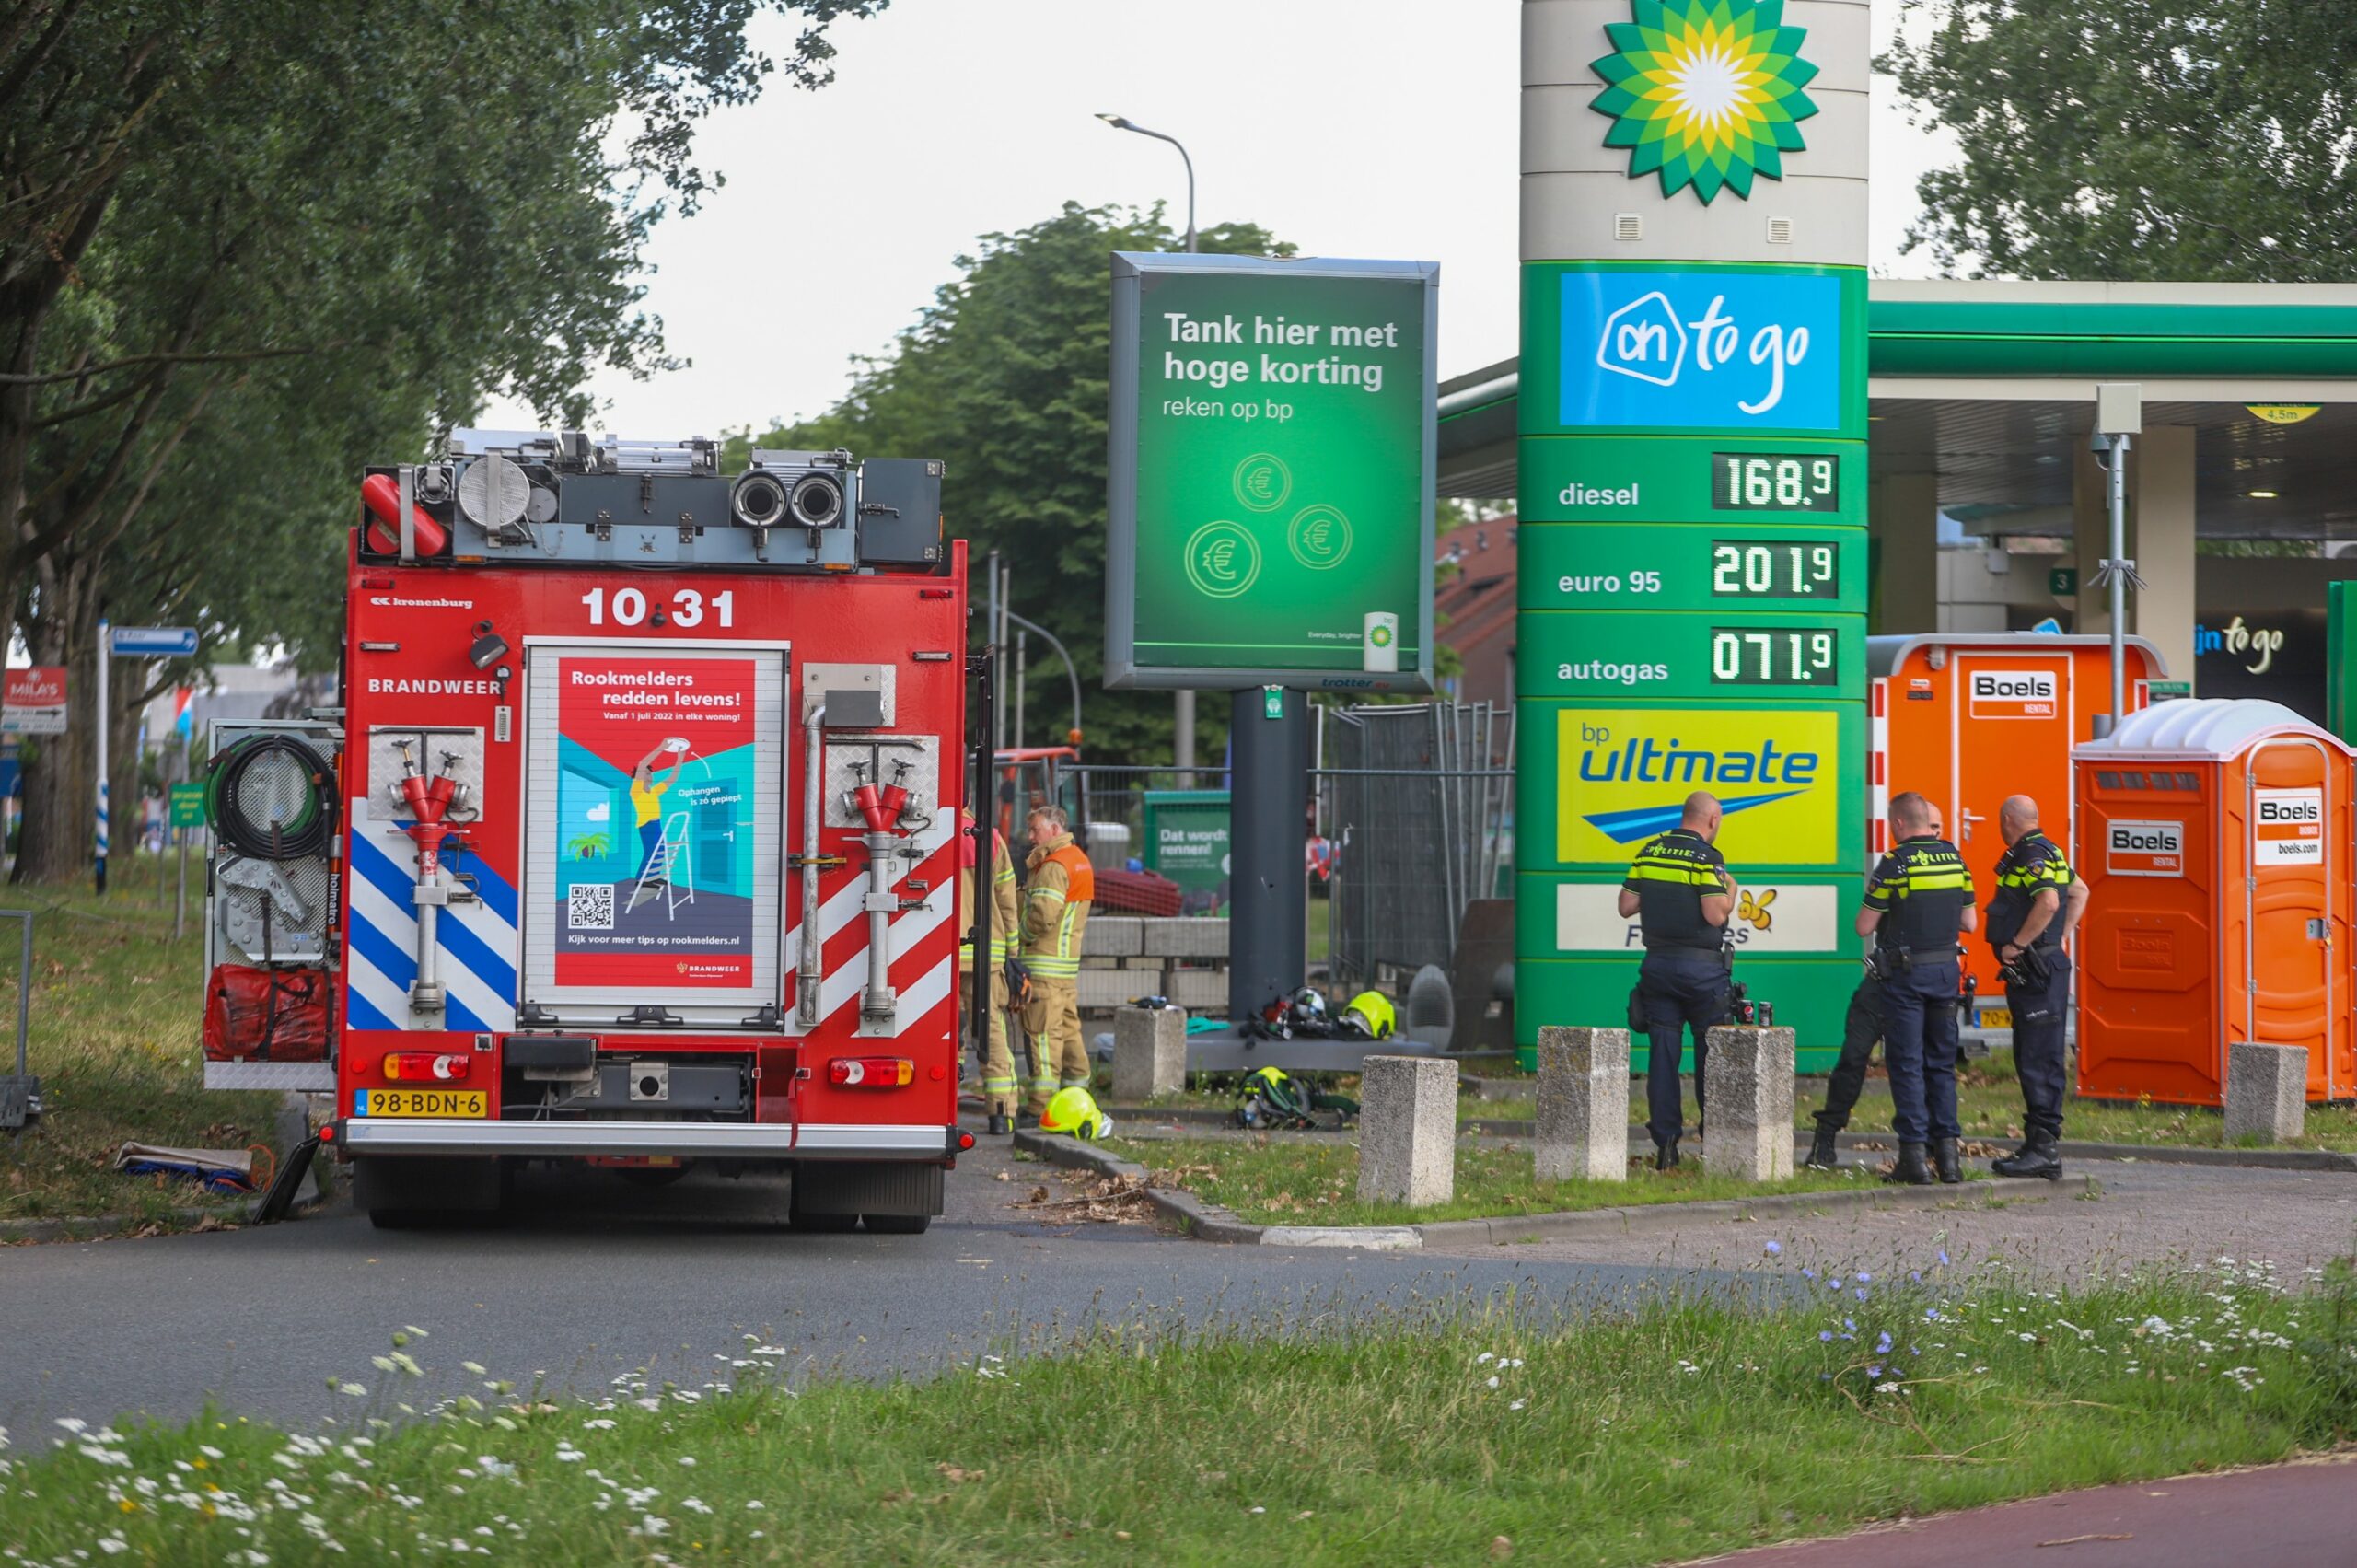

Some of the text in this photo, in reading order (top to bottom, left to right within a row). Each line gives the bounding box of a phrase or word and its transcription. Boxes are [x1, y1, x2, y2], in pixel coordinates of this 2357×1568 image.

[1163, 312, 1399, 348] Tank hier met
[1688, 295, 1739, 371] to
[1737, 324, 1810, 415] go
[1164, 351, 1383, 392] hoge korting
[1163, 396, 1294, 423] reken op bp
[1558, 459, 1832, 505] diesel 168.9
[1558, 546, 1832, 593] euro 95 201.9
[2057, 573, 2068, 589] 3
[393, 598, 473, 609] kronenburg
[581, 588, 734, 628] 10 31
[2223, 616, 2249, 655] to
[2246, 629, 2284, 675] go
[1557, 633, 1832, 686] autogas 071.9
[368, 679, 502, 694] BRANDWEER
[572, 670, 694, 686] Rookmelders
[1322, 679, 1373, 688] trotter
[1975, 676, 2051, 696] Boels
[10, 682, 59, 696] MILA'S
[603, 691, 741, 706] redden levens!
[603, 712, 628, 720] Vanaf
[631, 712, 635, 720] 1
[637, 712, 651, 721] juli
[685, 713, 703, 721] elke
[705, 714, 741, 722] woning!
[1581, 722, 1610, 746] bp
[678, 786, 721, 797] Ophangen
[691, 797, 698, 806] is
[710, 794, 742, 806] gepiept
[2260, 801, 2318, 820] Boels
[1160, 828, 1229, 842] Dat wordt
[2112, 830, 2177, 851] Boels
[1160, 842, 1213, 855] rennen!
[2278, 843, 2318, 854] boels.com
[328, 874, 341, 925] holmatro
[568, 935, 586, 944] Kijk
[637, 935, 655, 946] tips
[657, 937, 669, 946] op
[671, 935, 740, 945] rookmelders.nl
[373, 1093, 481, 1113] 98-BDN-6
